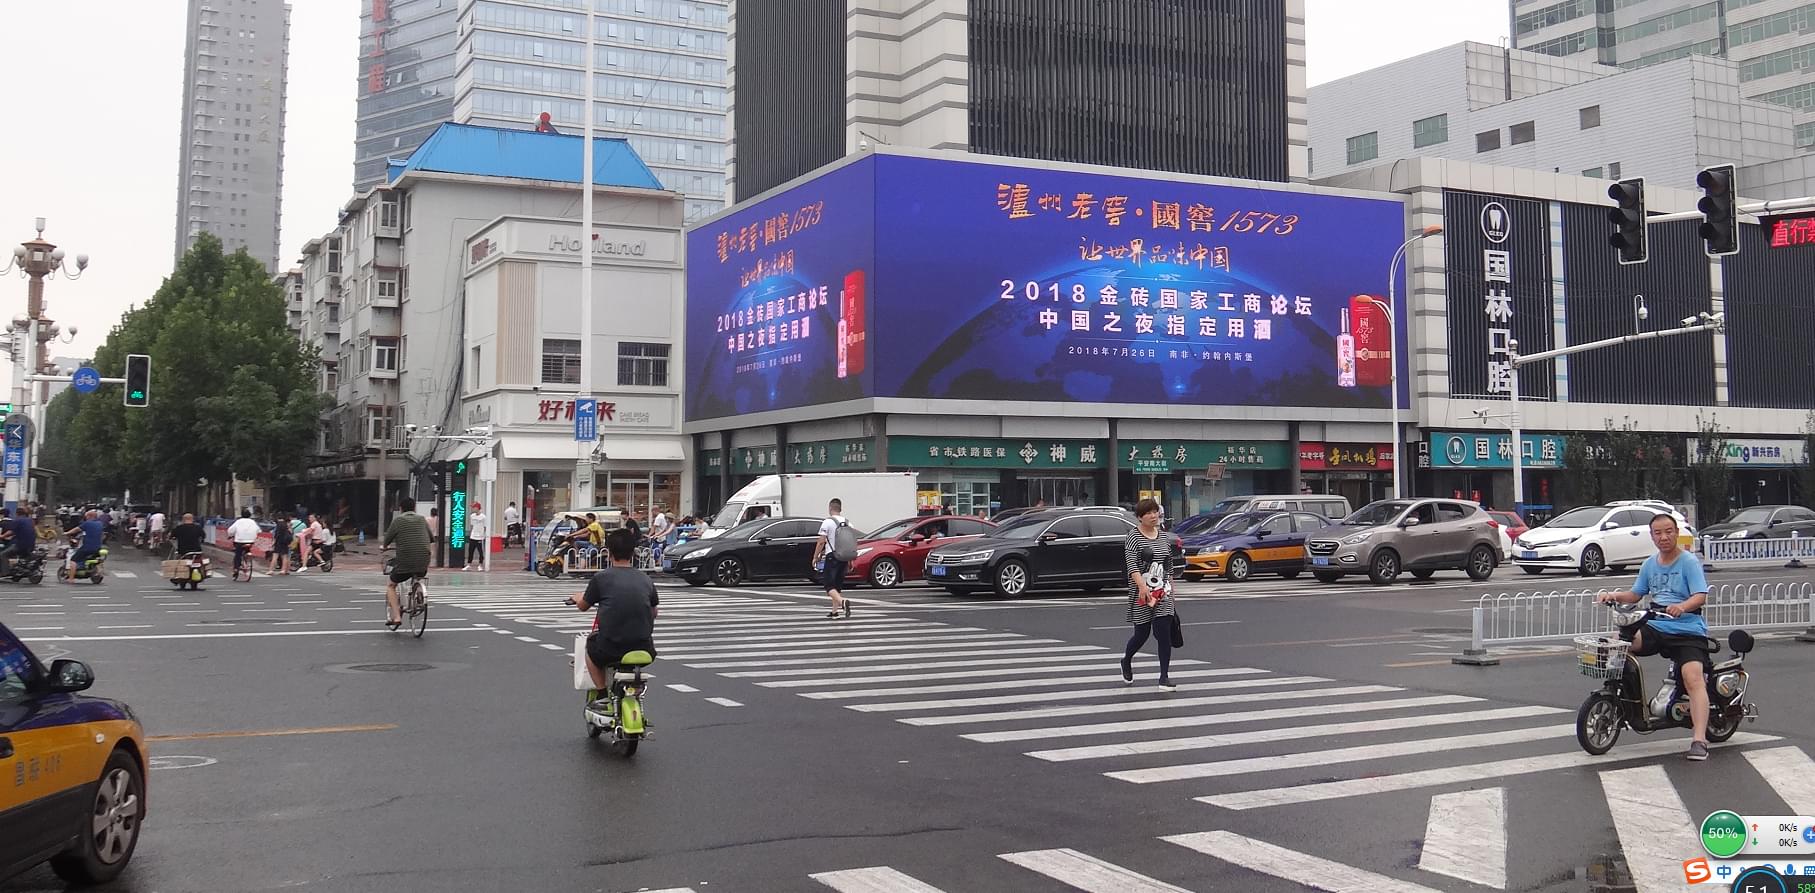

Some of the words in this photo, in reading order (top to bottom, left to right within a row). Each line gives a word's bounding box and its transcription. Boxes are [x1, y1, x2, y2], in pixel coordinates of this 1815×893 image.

[1079, 237, 1232, 273] 让世界品味中国
[717, 285, 828, 333] 2018金砖国家工商论坛
[1000, 278, 1313, 317] 2018金砖国家工商论坛
[1038, 308, 1273, 341] 中国之夜指定用酒
[1483, 248, 1514, 395] 国林口腔
[1068, 345, 1156, 359] 2018年7月26日
[929, 446, 1006, 459] 省市铁路医保
[1049, 444, 1097, 464] 神威
[1418, 441, 1430, 469] 口腔
[1475, 437, 1557, 460] 国林口腔
[1752, 446, 1781, 458] 新兴药房
[452, 491, 466, 549] 行人安全通行
